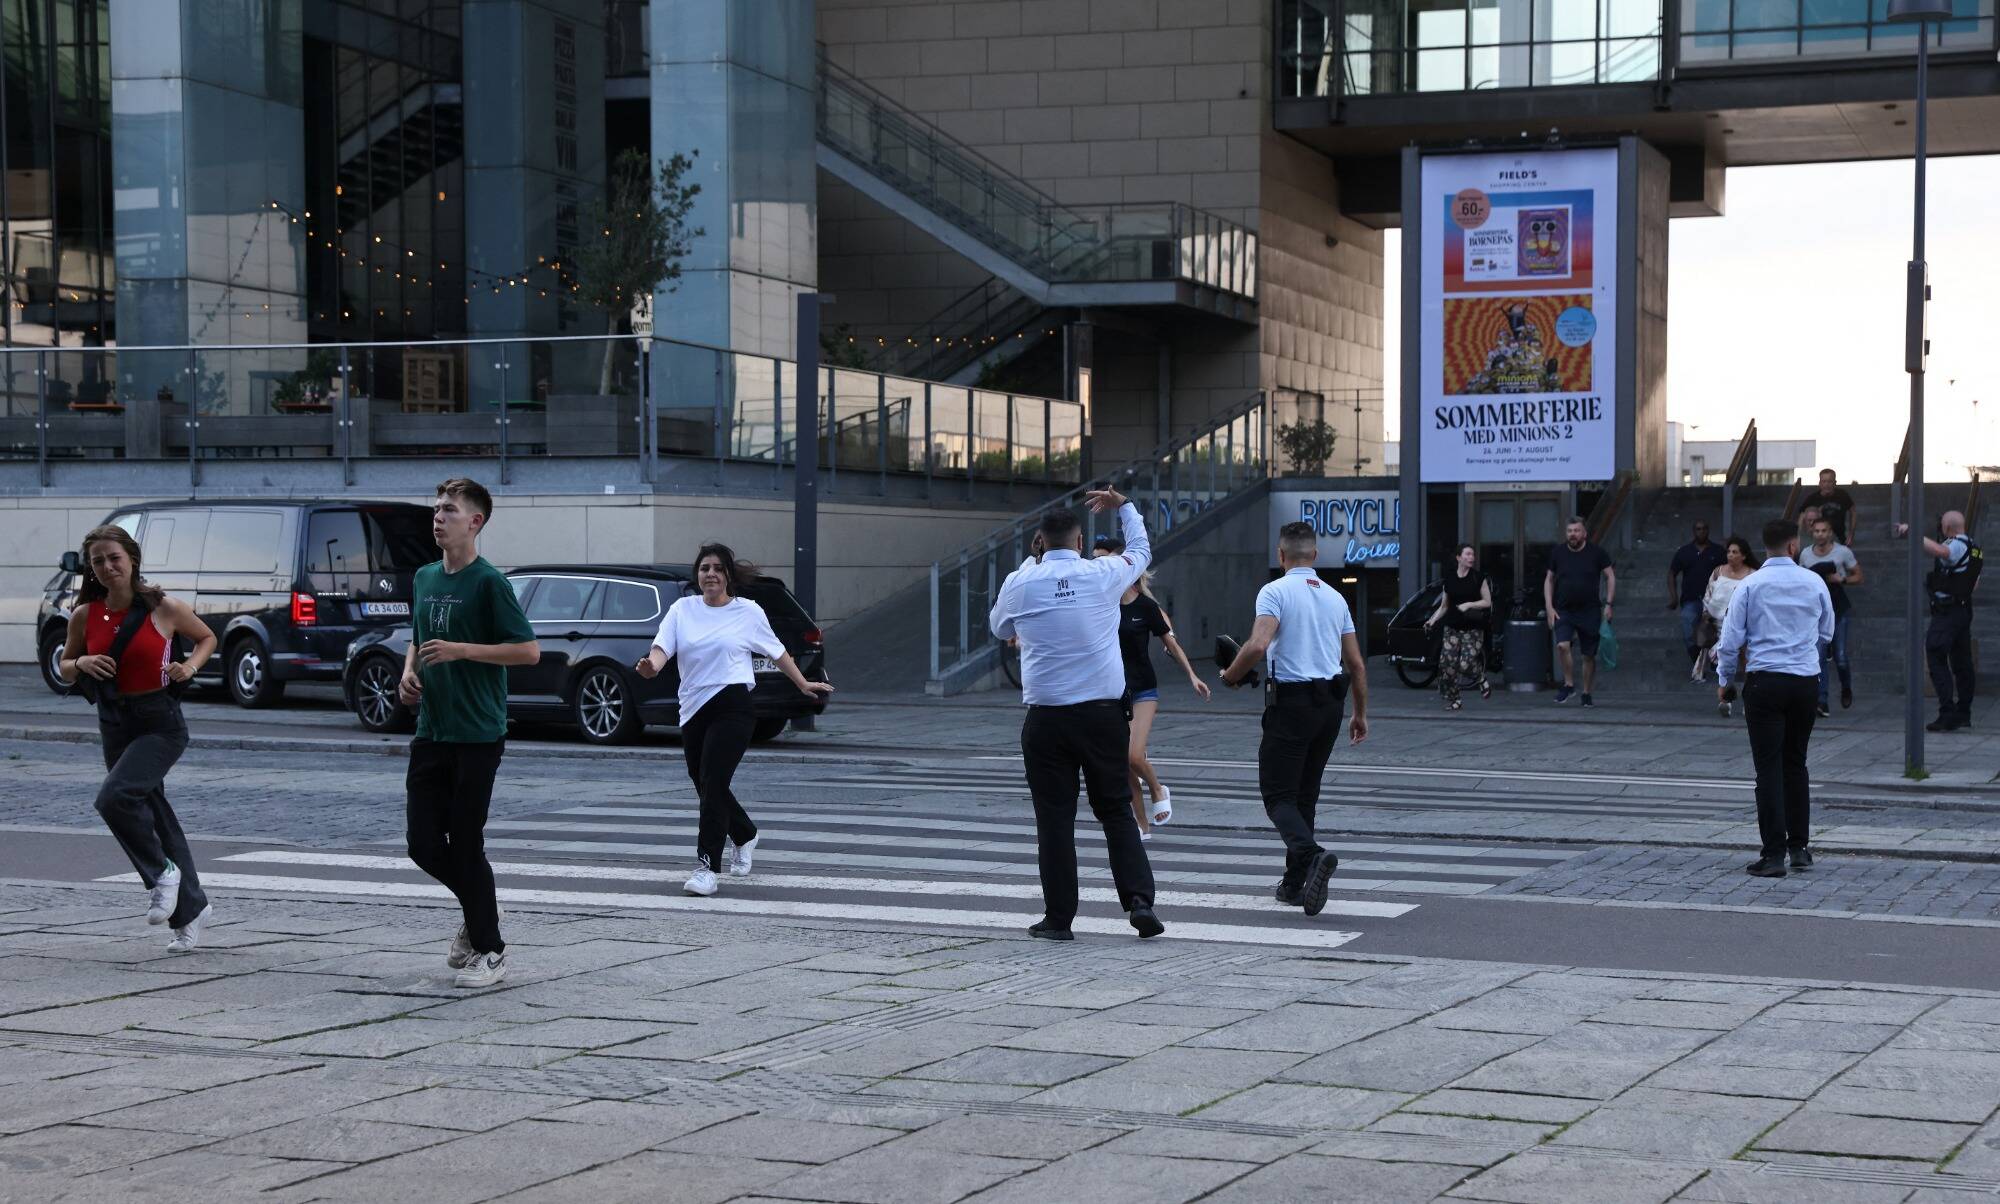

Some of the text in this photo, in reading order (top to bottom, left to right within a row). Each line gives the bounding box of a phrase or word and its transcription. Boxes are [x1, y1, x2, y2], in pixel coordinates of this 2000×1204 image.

[1499, 170, 1537, 180] FIELD'S
[1435, 397, 1602, 430] SOMMERFERIE
[1464, 424, 1573, 445] MED MINIONS 2
[1495, 447, 1512, 455] JUNI
[1525, 446, 1554, 454] AUGUST
[368, 603, 408, 613] CA 34 003
[754, 660, 765, 671] BP
